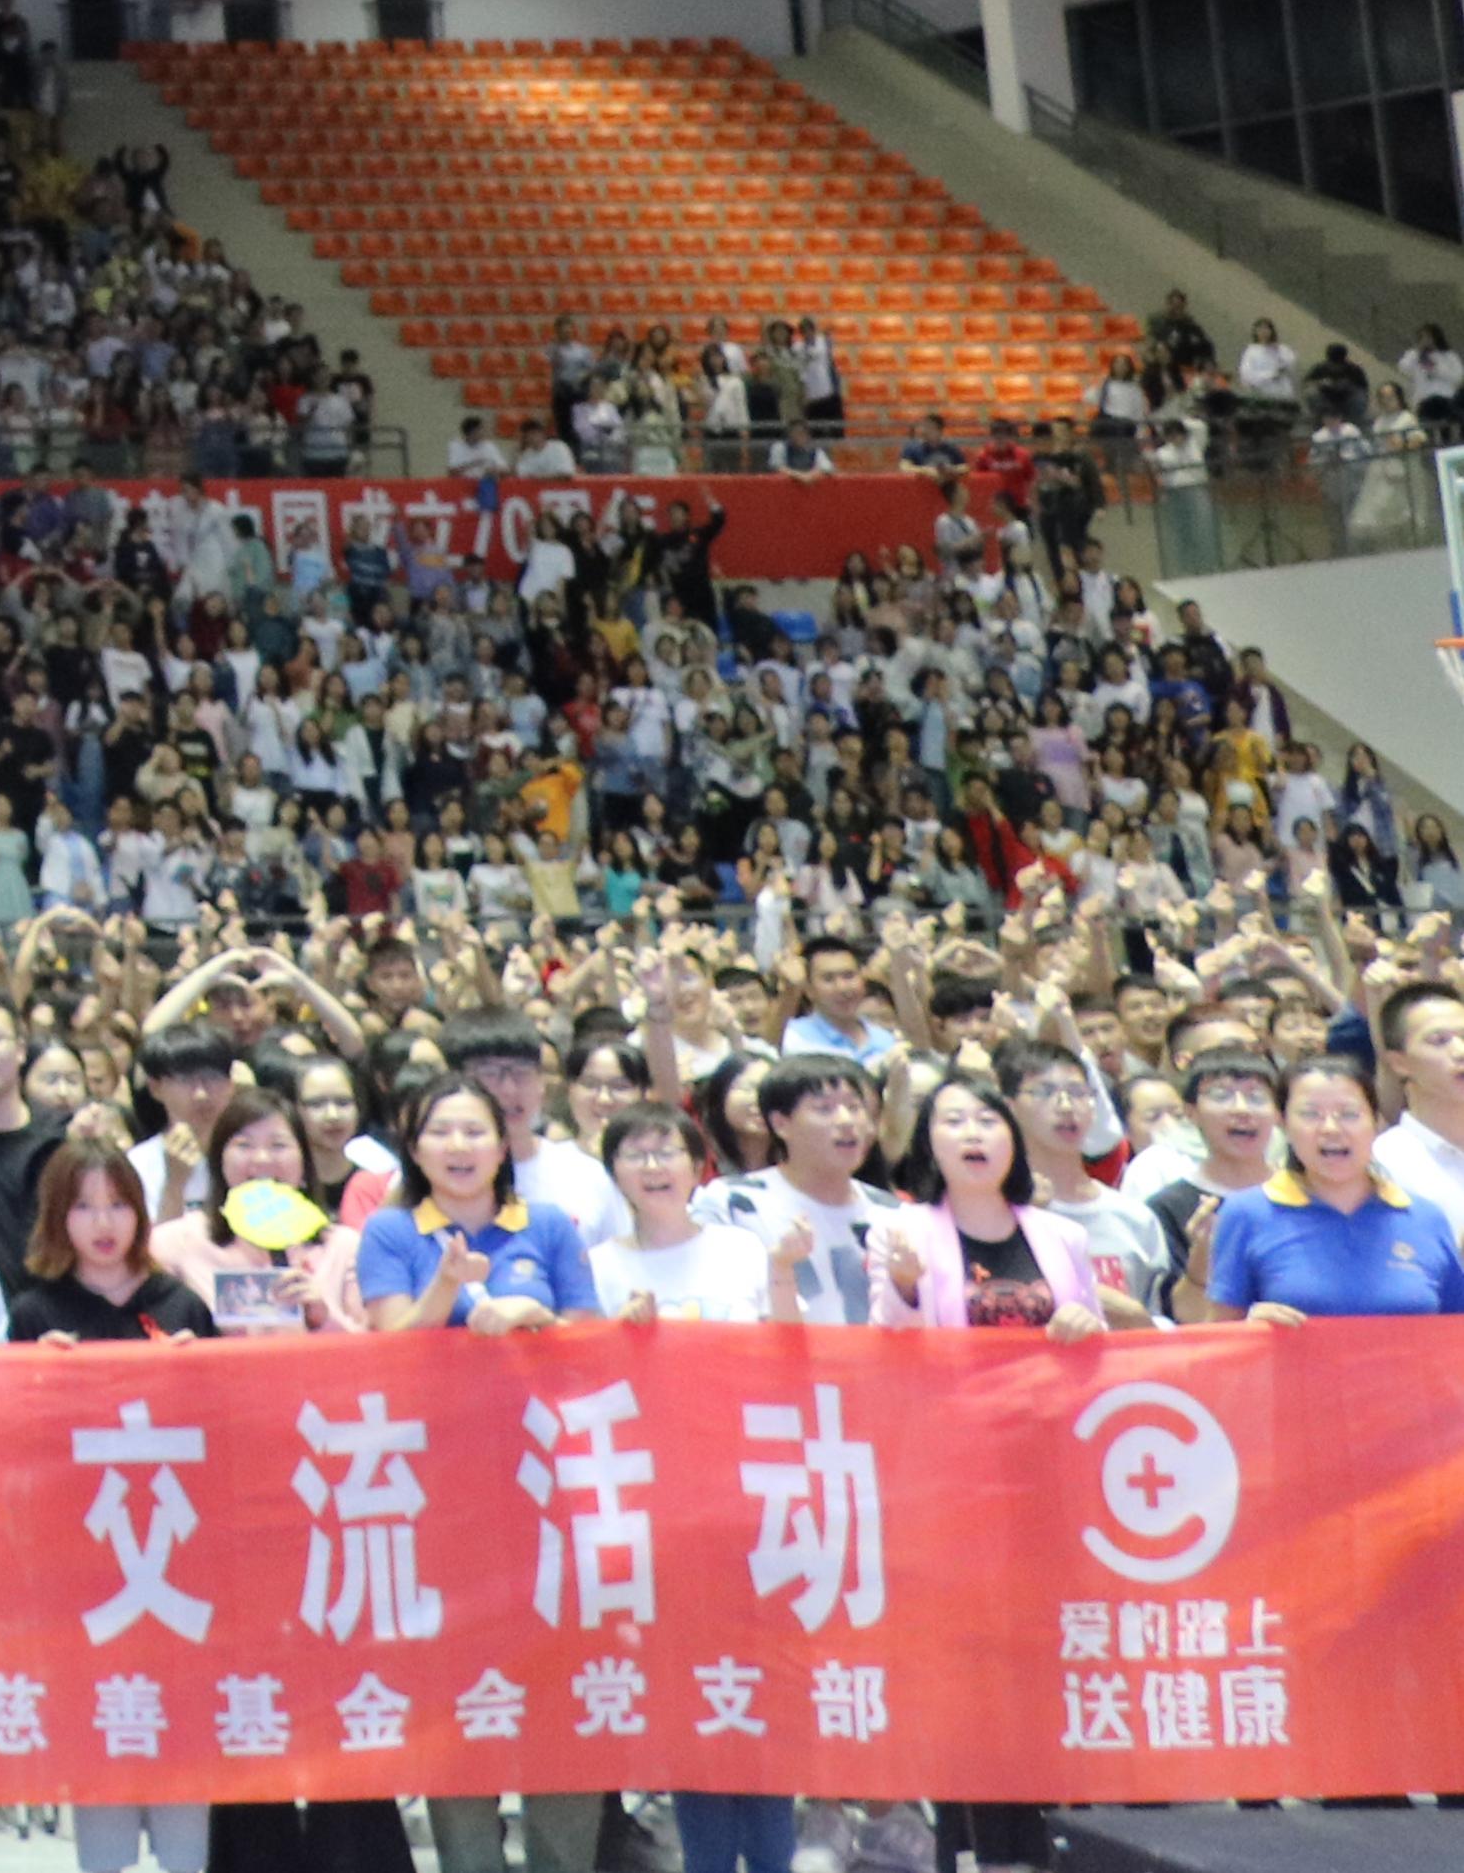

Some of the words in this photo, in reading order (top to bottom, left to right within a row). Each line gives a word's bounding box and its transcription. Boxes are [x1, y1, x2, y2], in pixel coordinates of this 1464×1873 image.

[1060, 1597, 1287, 1661] 爱的路上
[1060, 1665, 1291, 1750] 送健康
